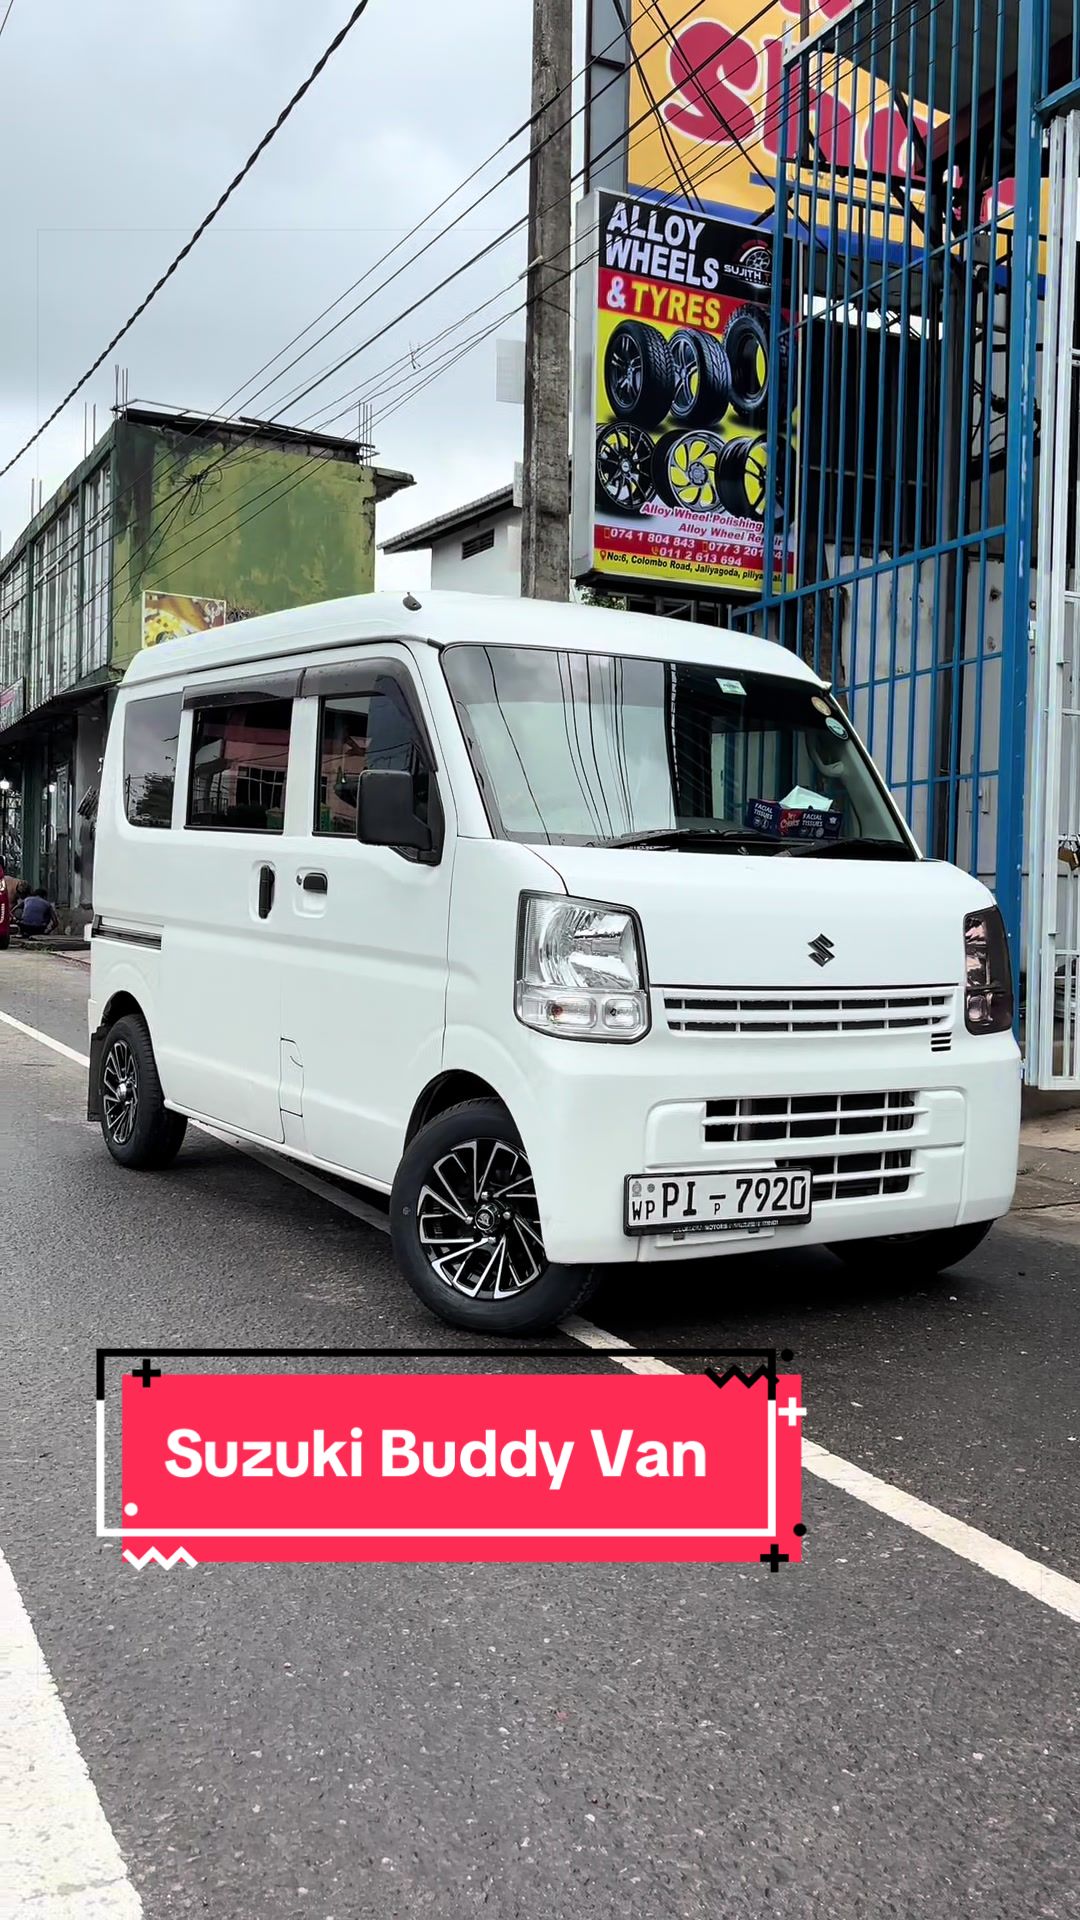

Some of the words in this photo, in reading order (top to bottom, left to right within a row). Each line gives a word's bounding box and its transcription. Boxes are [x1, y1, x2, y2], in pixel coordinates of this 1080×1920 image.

[606, 201, 706, 250] ALLOY
[605, 233, 719, 289] WHEELS
[723, 264, 762, 281] SUJITH
[606, 276, 626, 309] &
[631, 281, 721, 330] TYRES
[641, 503, 671, 518] Alloy
[674, 508, 710, 523] Wheel
[610, 528, 633, 541] 074
[637, 532, 644, 541] 1
[647, 533, 670, 545] 804
[673, 537, 695, 549] 843
[678, 523, 707, 537] Alloy
[711, 528, 745, 541] Wheel
[747, 532, 784, 547] Reir
[659, 547, 681, 559] 011
[685, 551, 692, 560] 2
[695, 553, 717, 563] 613
[720, 556, 742, 566] 694
[708, 542, 730, 553] 077
[733, 545, 740, 554] 3
[607, 551, 629, 564] No:6,
[631, 555, 668, 568] Colombo
[669, 561, 693, 572] Road,
[695, 564, 740, 579] Jaliyagoda,
[753, 808, 774, 820] TISSUES
[754, 802, 773, 814] FACIAL
[802, 812, 823, 820] FACIAL
[736, 1176, 806, 1213] 7920
[631, 1200, 655, 1220] WP
